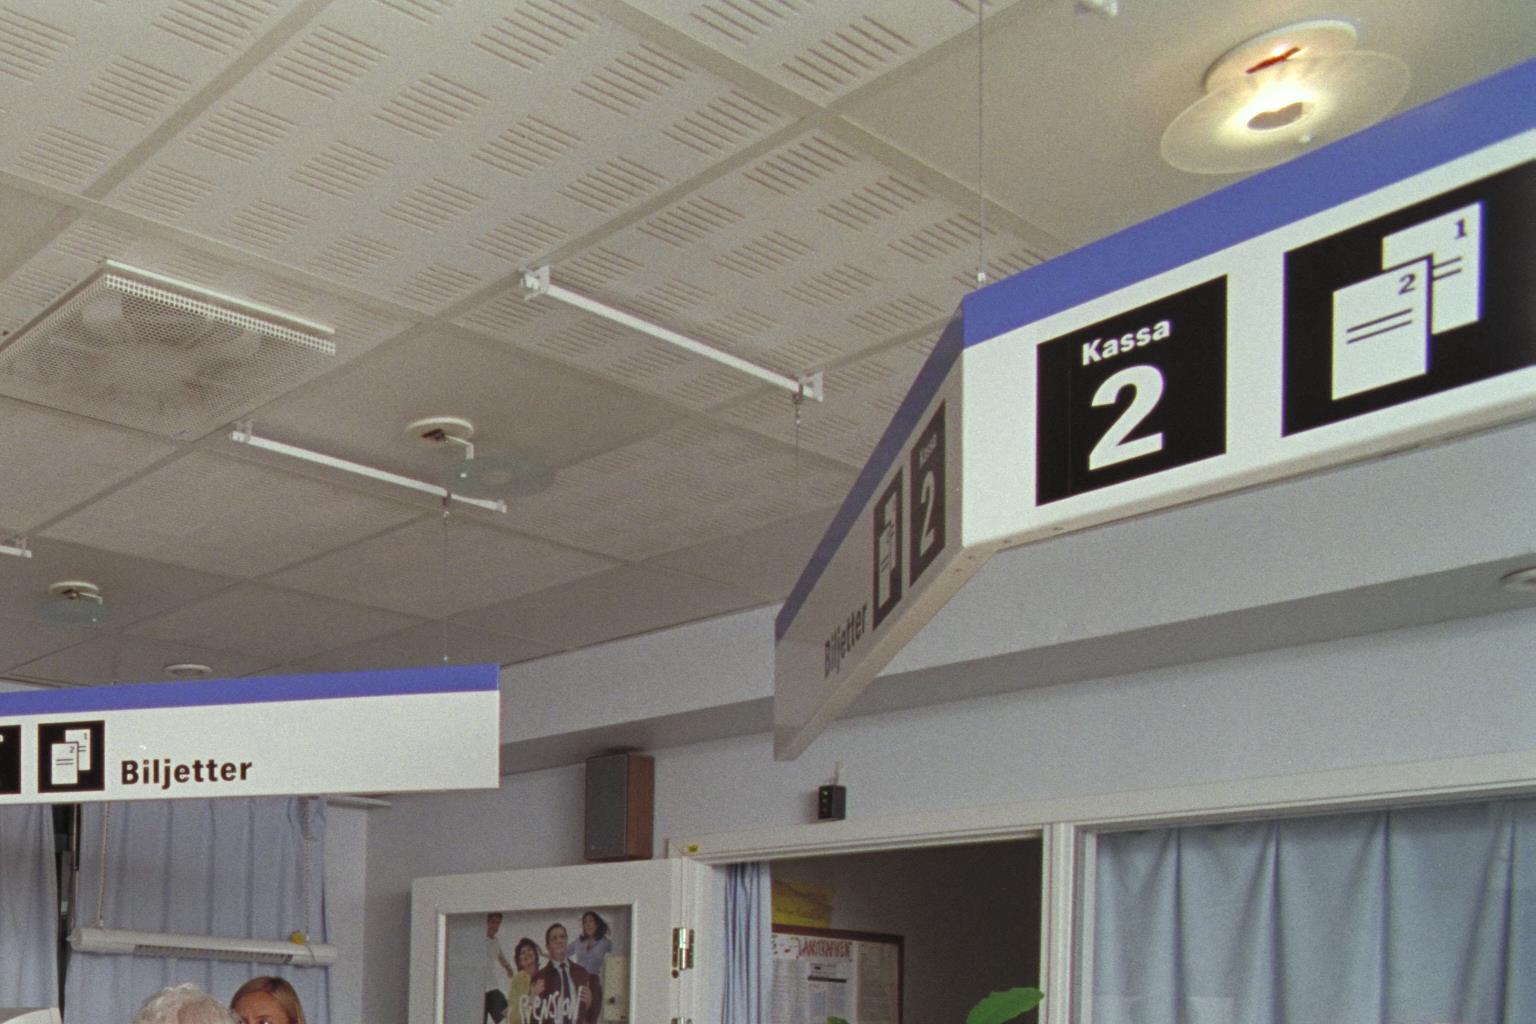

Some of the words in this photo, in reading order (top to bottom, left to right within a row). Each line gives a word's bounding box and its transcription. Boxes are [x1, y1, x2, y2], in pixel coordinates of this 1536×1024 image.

[1455, 219, 1467, 240] 1
[1398, 273, 1416, 294] 2
[1082, 319, 1171, 366] Kassa
[1088, 365, 1164, 471] 2
[920, 470, 936, 557] 2
[824, 603, 868, 679] Biljetter
[121, 759, 253, 790] Biljetter
